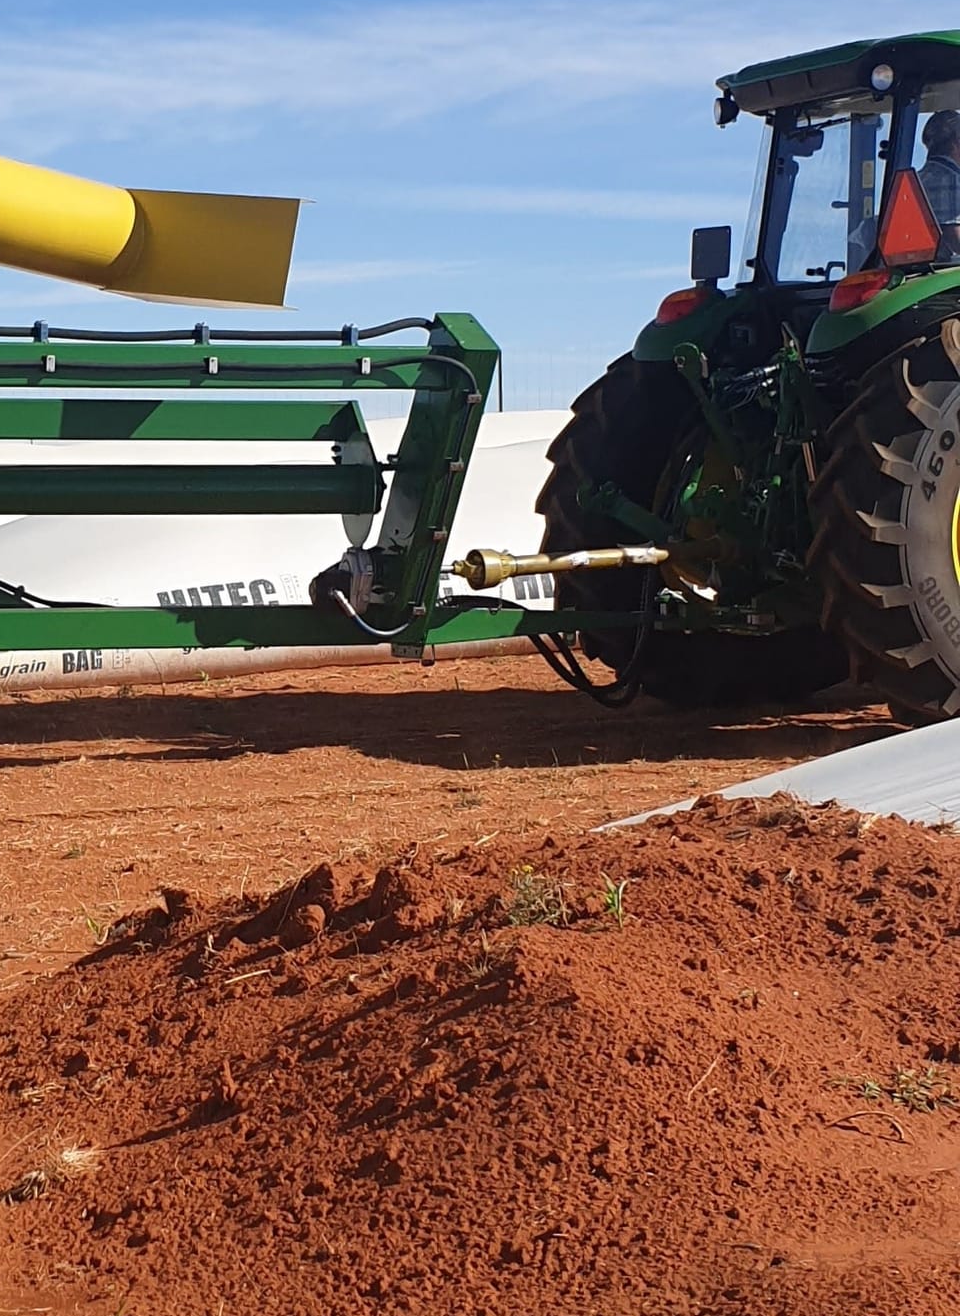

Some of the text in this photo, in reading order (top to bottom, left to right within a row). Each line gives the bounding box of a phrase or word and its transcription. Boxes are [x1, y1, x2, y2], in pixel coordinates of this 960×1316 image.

[921, 429, 956, 503] 460
[0, 658, 46, 678] grain
[62, 650, 102, 674] BAG
